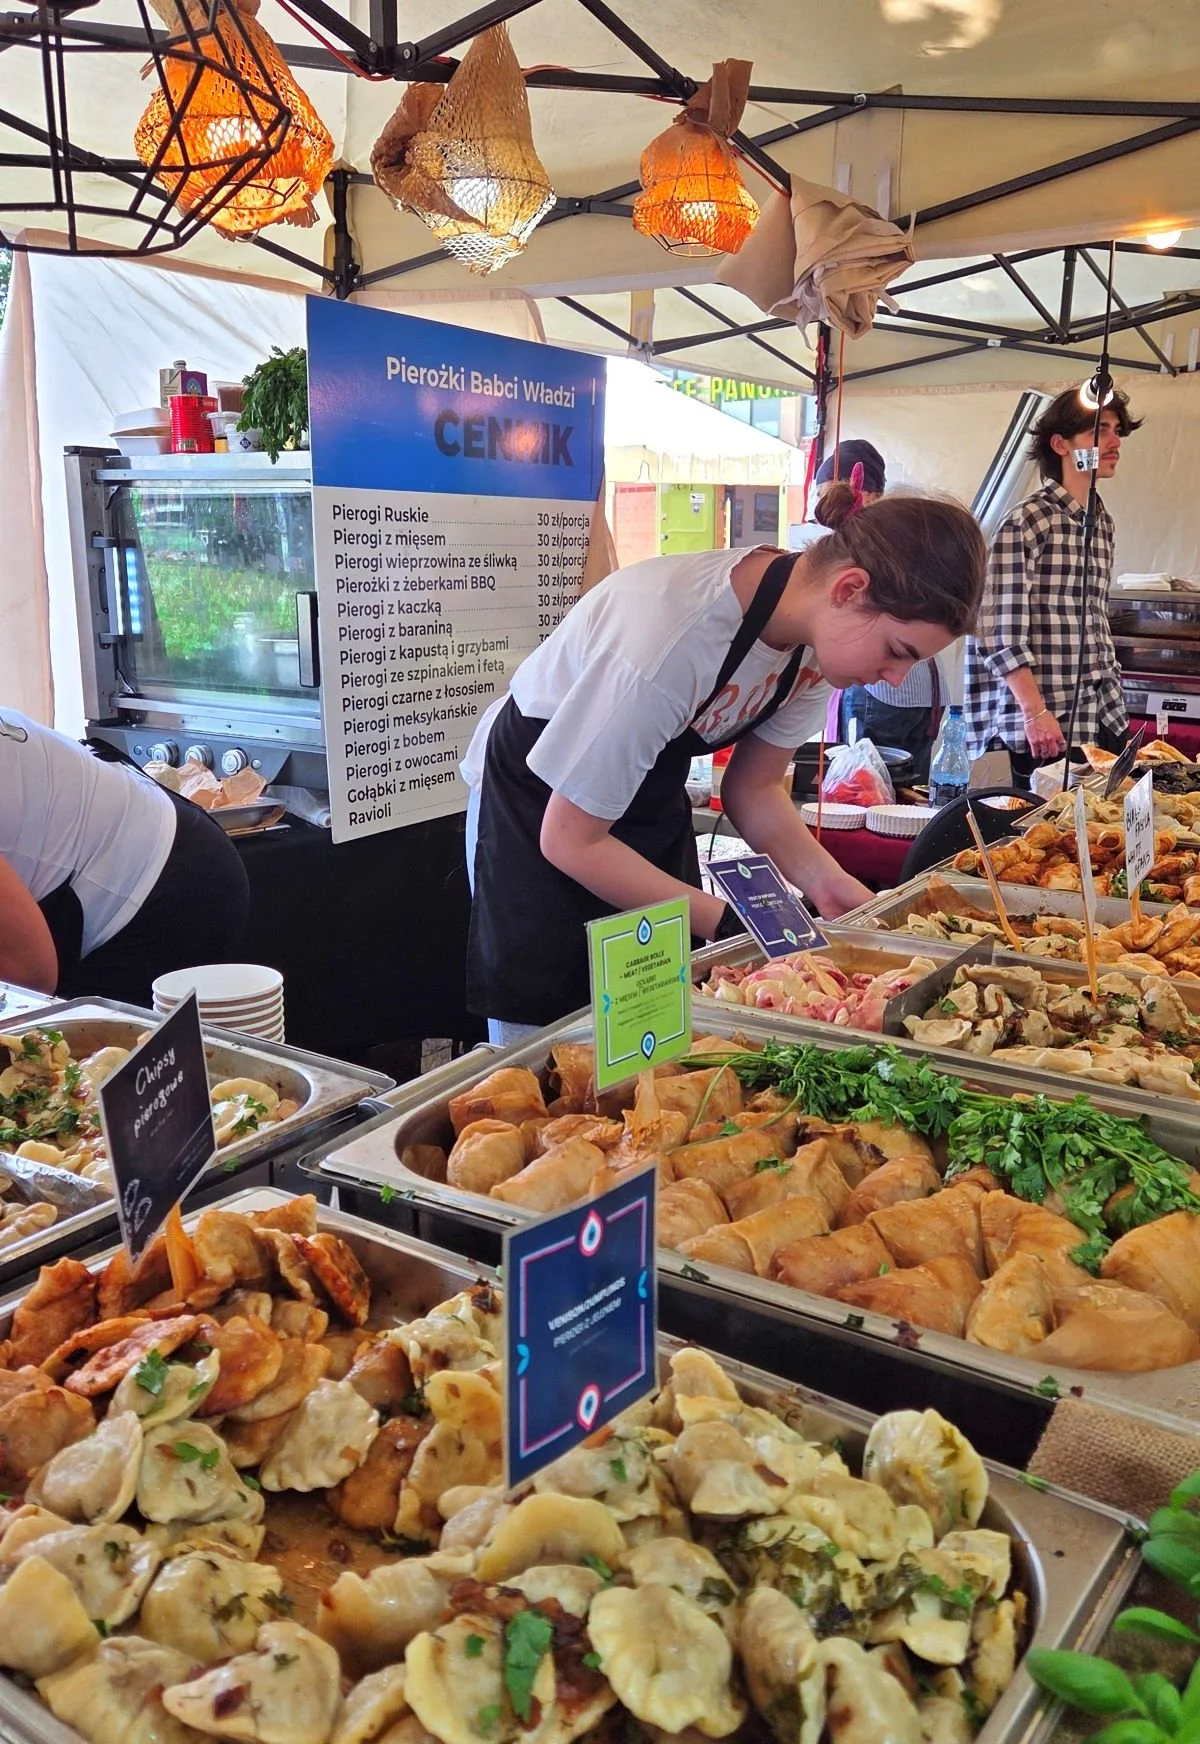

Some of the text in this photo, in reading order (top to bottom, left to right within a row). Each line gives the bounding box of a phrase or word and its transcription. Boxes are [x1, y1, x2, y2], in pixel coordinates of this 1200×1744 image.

[386, 356, 576, 409] Pierożki Babci Władzi
[332, 504, 590, 530] Pierogi Ruskie 30 zł/porcja
[333, 529, 590, 550] Pierogi z mięsem 30 zł/porcja
[335, 553, 383, 572] Pierogi
[386, 554, 466, 573] wieprzowina
[468, 556, 481, 568] ze
[483, 553, 518, 569] śliwką
[537, 554, 550, 567] 30
[336, 576, 390, 594] Pierożki
[393, 581, 400, 591] z
[403, 573, 468, 592] żeberkami
[470, 575, 496, 591] BBQ
[537, 574, 550, 587] 30
[337, 600, 385, 619] Pierogi
[388, 604, 394, 615] z
[397, 599, 442, 617] kaczką
[538, 594, 550, 607] 30
[338, 623, 386, 642] Pierogi
[389, 627, 396, 638] z
[399, 621, 453, 638] baraniną
[538, 614, 551, 627] 30
[340, 646, 386, 666] Pierogi
[389, 649, 397, 661] z
[400, 642, 449, 663] kapustą
[451, 641, 455, 655] i
[457, 636, 509, 656] grzybami
[341, 658, 505, 688] Pierogi ze szpinakiem i fetą
[342, 680, 495, 712] Pierogi czarne z łososiem
[343, 702, 478, 735] Pierogi meksykańskie
[345, 730, 445, 758] Pierogi z bobem
[346, 746, 458, 781] Pierogi z owocami
[347, 770, 455, 805] Gołąbki z mięsem
[349, 802, 391, 826] Ravioli
[135, 1047, 175, 1096] Chipsy
[133, 1070, 183, 1138] pierogowe
